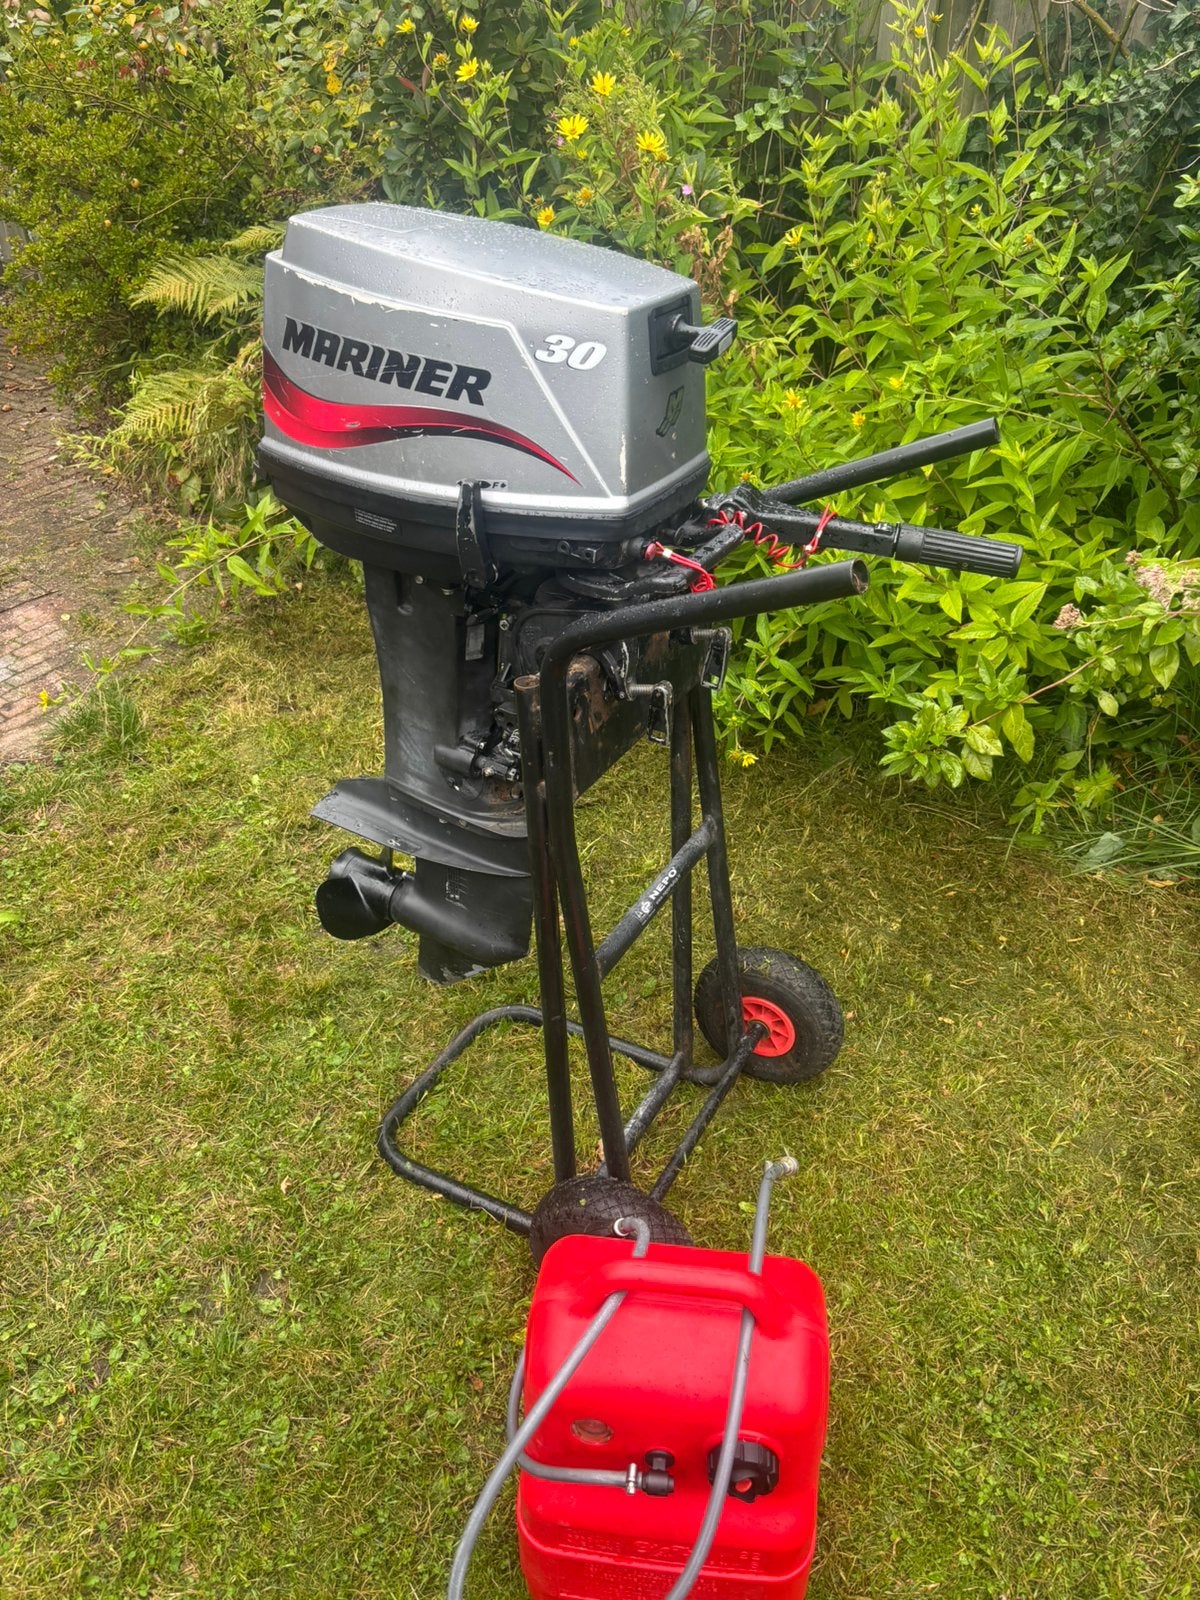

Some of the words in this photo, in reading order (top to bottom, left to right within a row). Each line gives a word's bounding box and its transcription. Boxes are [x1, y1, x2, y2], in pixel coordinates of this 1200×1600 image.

[282, 316, 492, 406] MARINER
[534, 334, 607, 370] 30
[649, 869, 677, 900] NEPO
